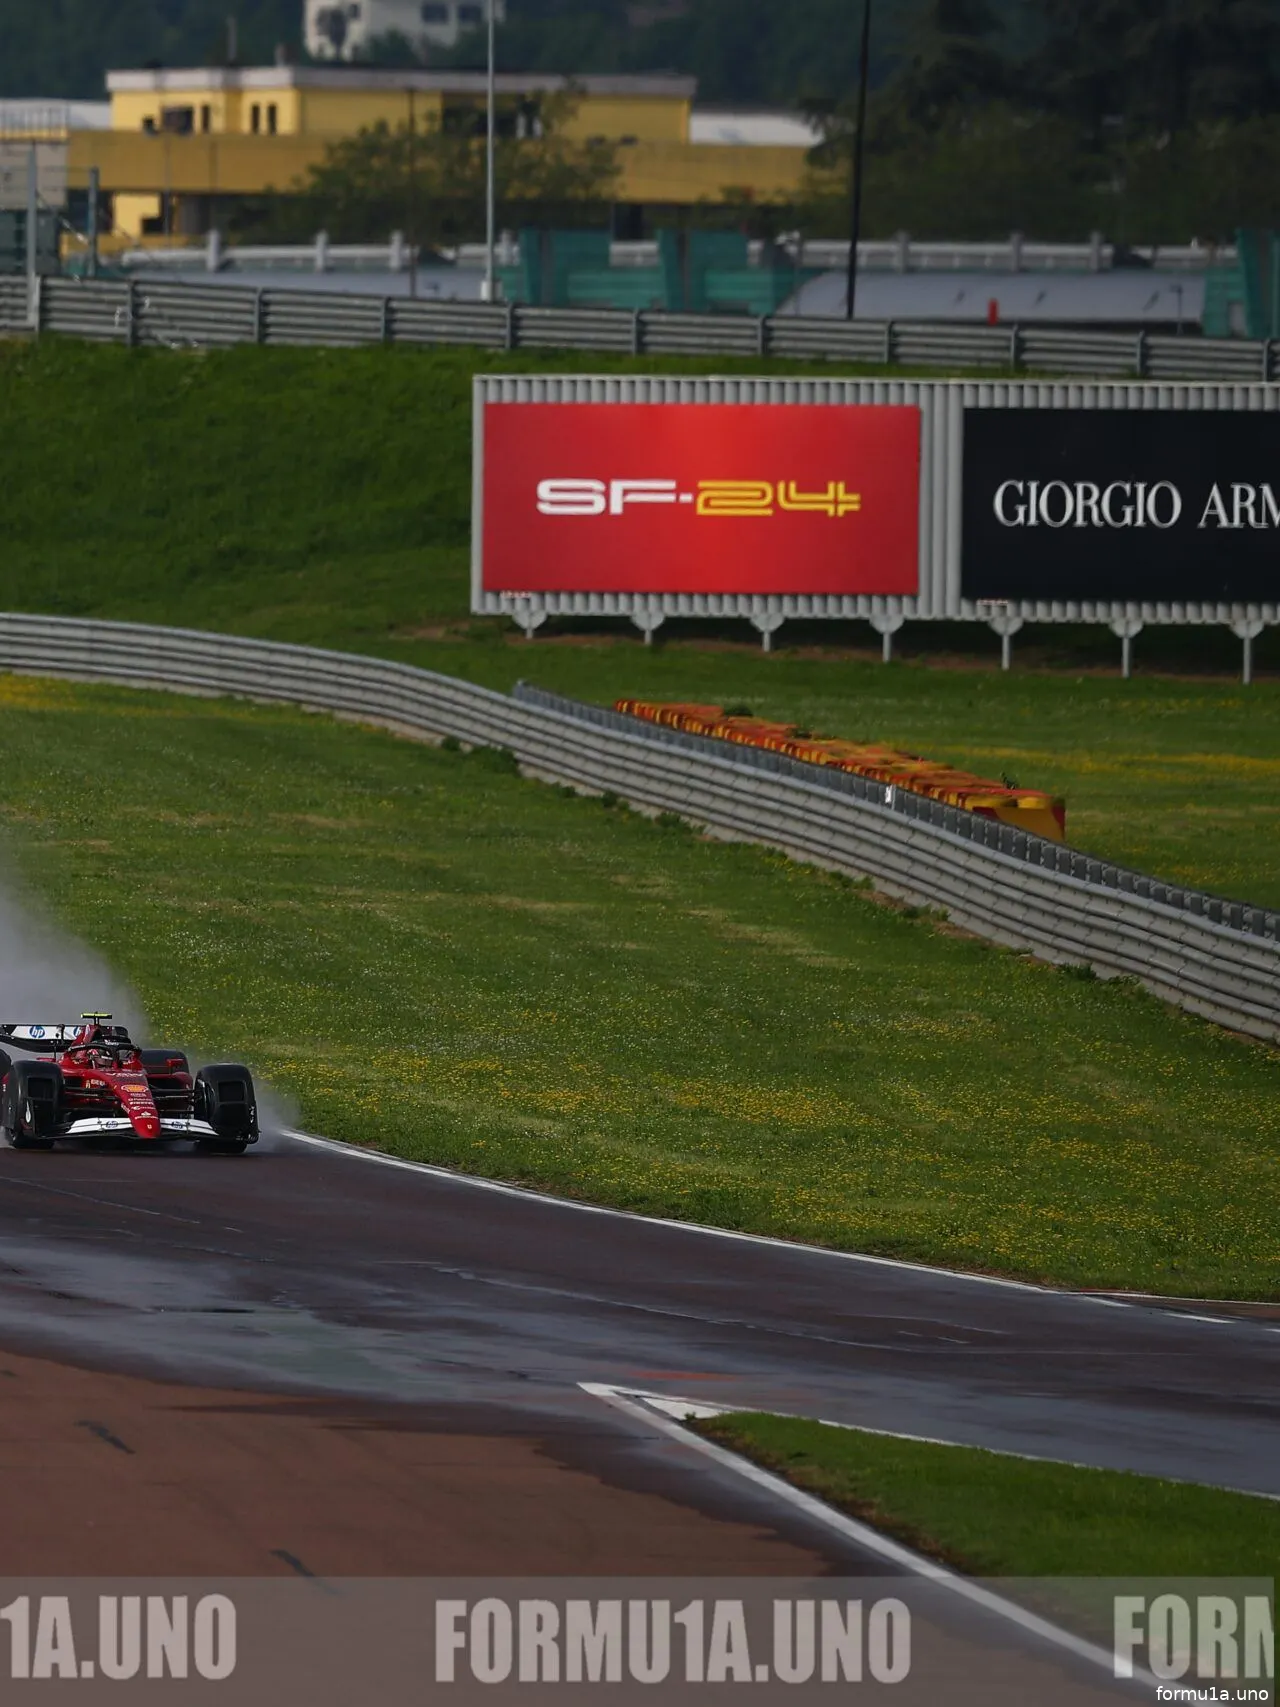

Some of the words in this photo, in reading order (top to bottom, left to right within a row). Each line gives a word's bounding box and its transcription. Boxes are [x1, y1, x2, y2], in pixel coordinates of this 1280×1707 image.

[536, 478, 861, 517] SF-24
[992, 479, 1183, 528] GIORGIO
[31, 1026, 44, 1038] hp
